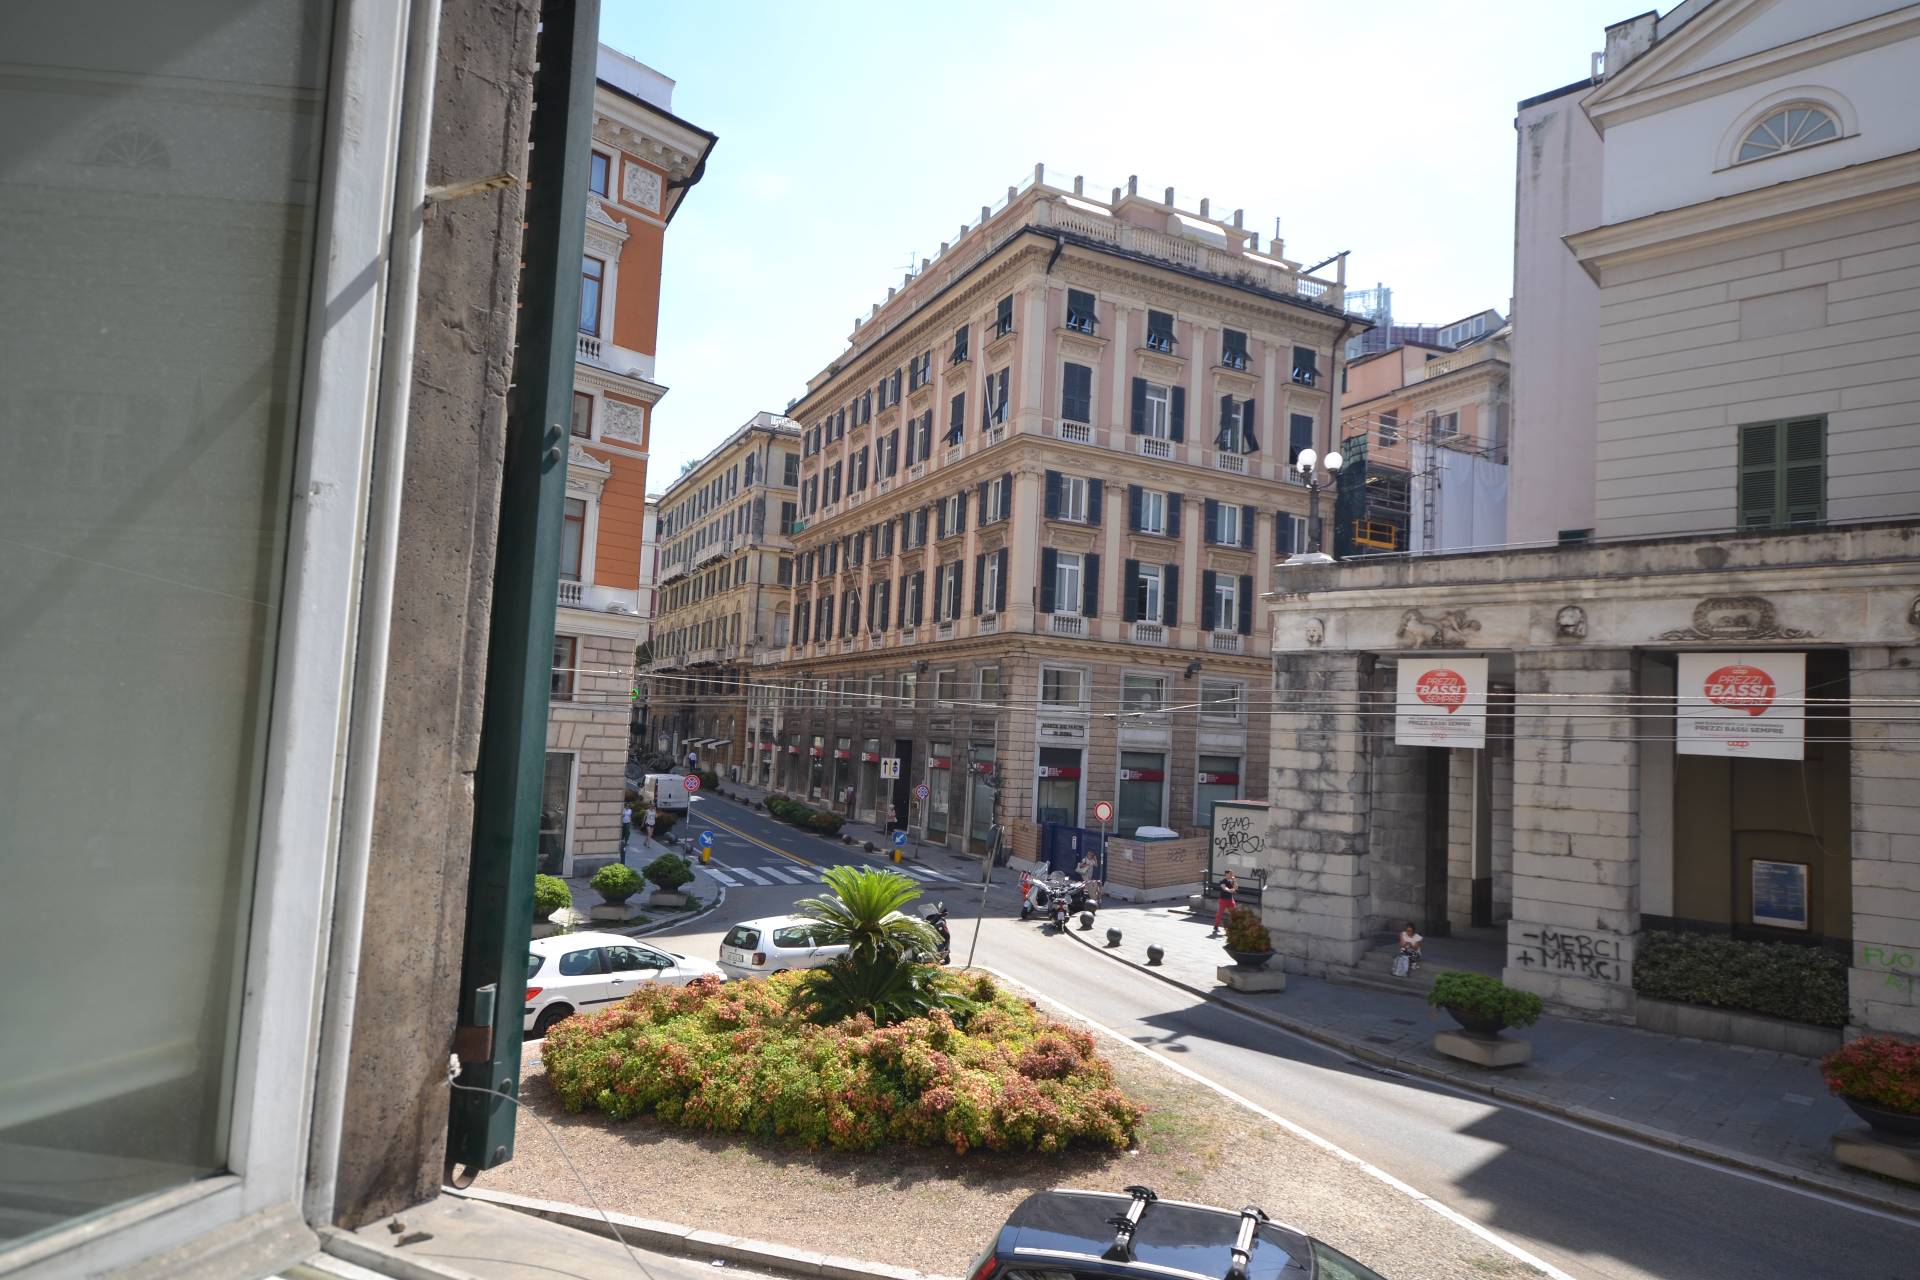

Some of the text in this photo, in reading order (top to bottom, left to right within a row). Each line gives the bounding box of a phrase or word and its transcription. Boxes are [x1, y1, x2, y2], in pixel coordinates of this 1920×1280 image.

[1427, 677, 1457, 685] PREZZI
[1718, 676, 1762, 684] PREZZI
[1420, 685, 1462, 695] BASSI
[1710, 685, 1768, 696] BASSI
[1426, 695, 1462, 703] SEMPRE
[1541, 930, 1620, 961] MERCI
[1541, 948, 1620, 982] MARCI
